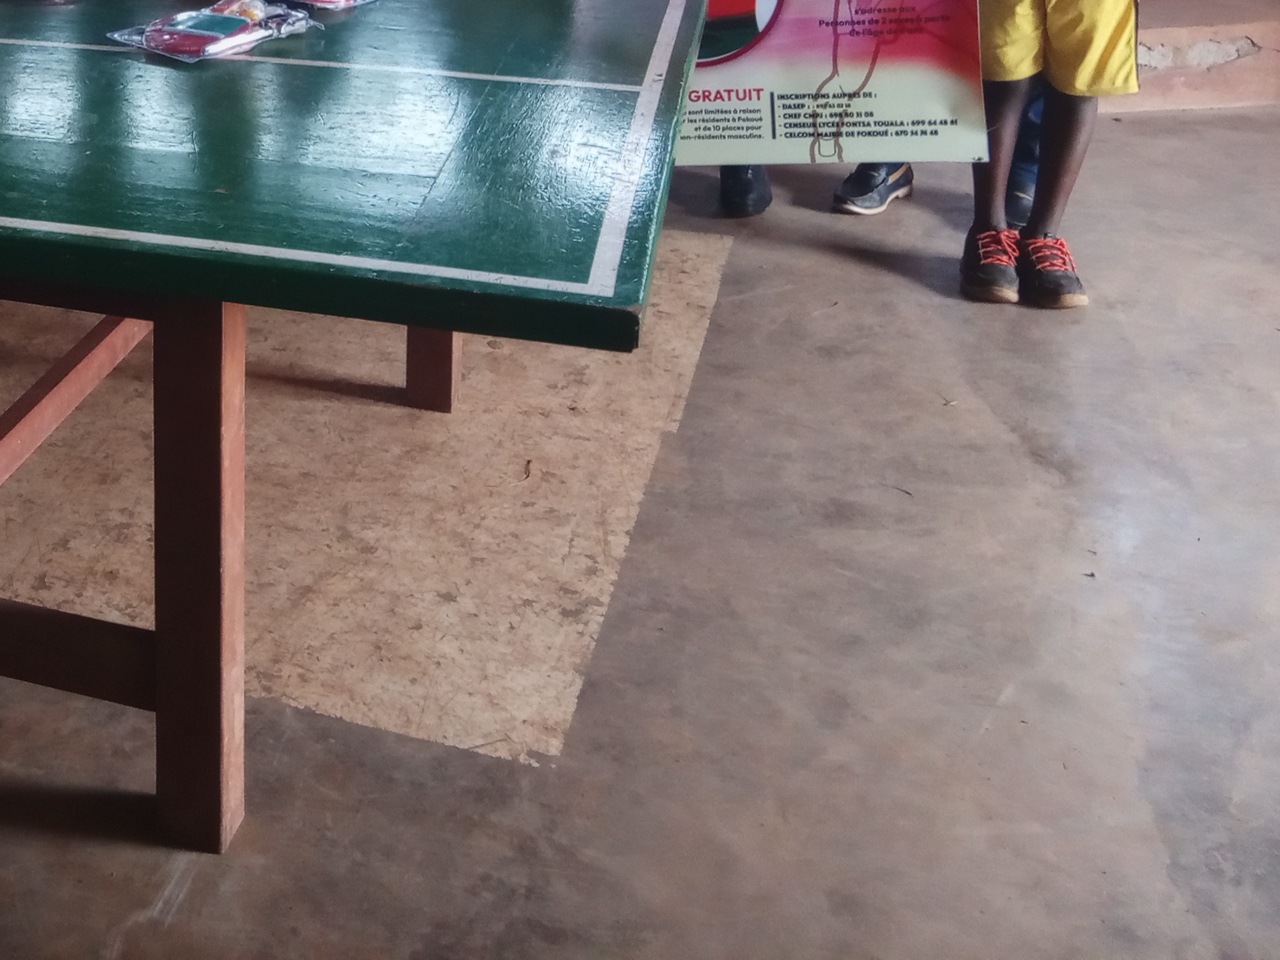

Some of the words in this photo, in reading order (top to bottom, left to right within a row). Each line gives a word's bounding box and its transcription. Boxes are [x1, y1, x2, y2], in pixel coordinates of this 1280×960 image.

[688, 88, 764, 102] GRATUIT
[862, 91, 873, 99] DE
[704, 107, 732, 116] limitées
[698, 116, 731, 124] résidents
[722, 124, 744, 133] places
